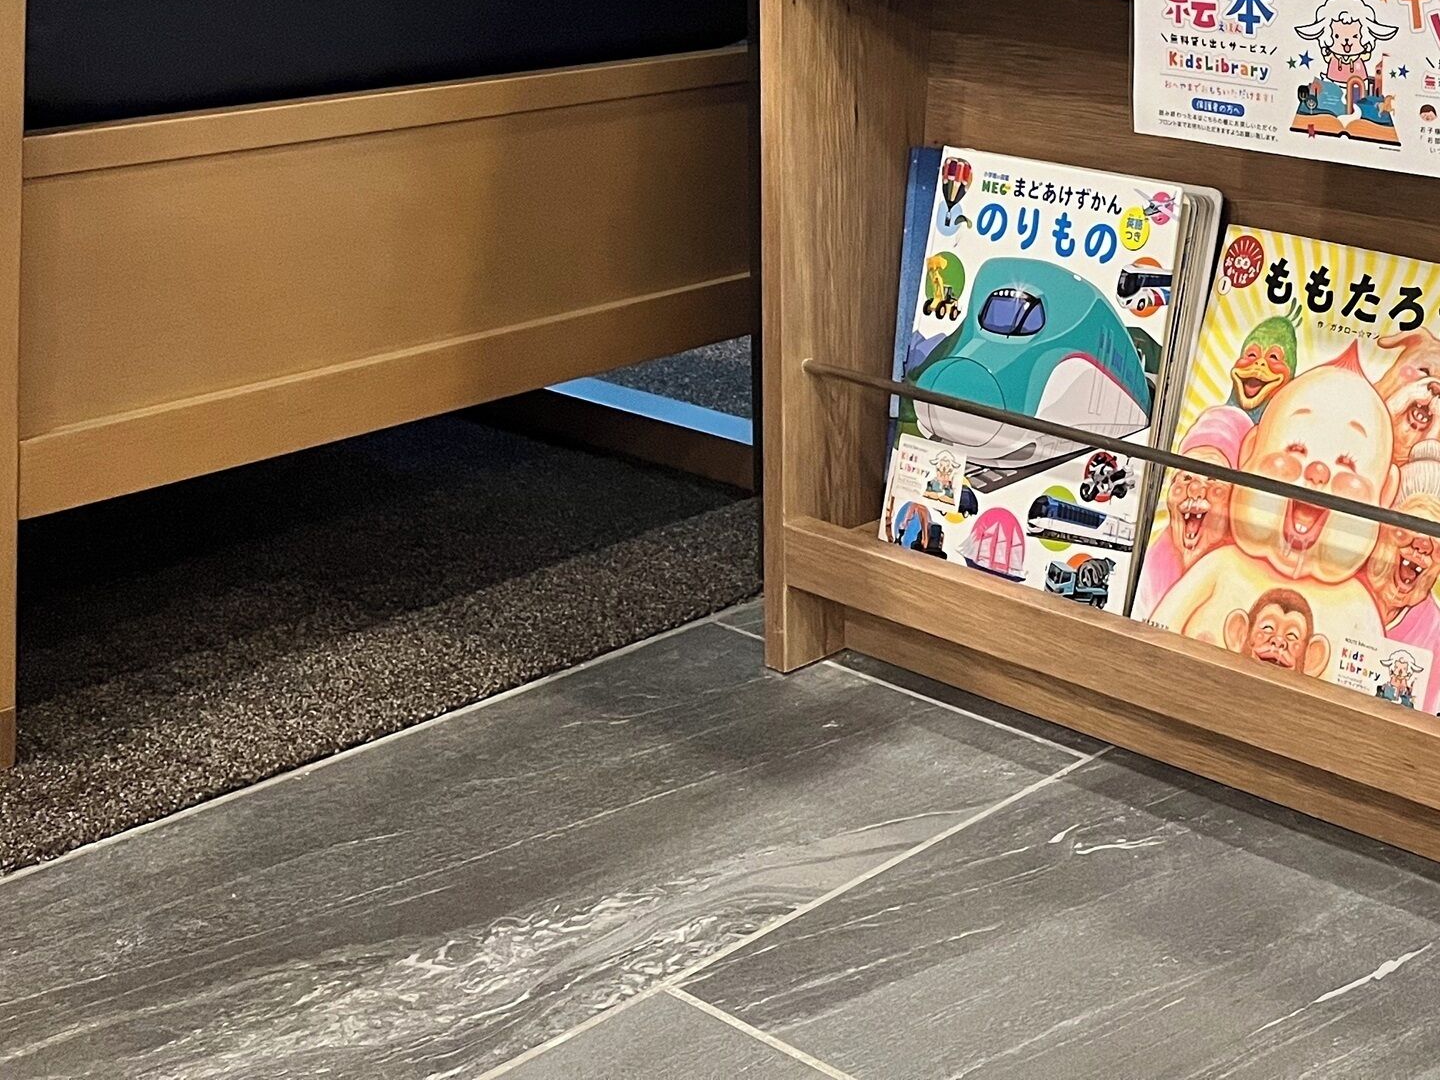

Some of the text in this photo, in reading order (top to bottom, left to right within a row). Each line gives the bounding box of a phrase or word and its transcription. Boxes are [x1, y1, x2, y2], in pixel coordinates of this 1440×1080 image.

[1170, 33, 1267, 55] 無料貸し出しサービス
[1196, 100, 1241, 115] 保護者の方へ
[1013, 177, 1122, 216] まどあけずかん
[1126, 217, 1144, 230] 英語
[976, 203, 1118, 264] のりもの
[1125, 230, 1142, 243] つき
[1341, 647, 1365, 662] Kids
[1339, 660, 1381, 681] Library
